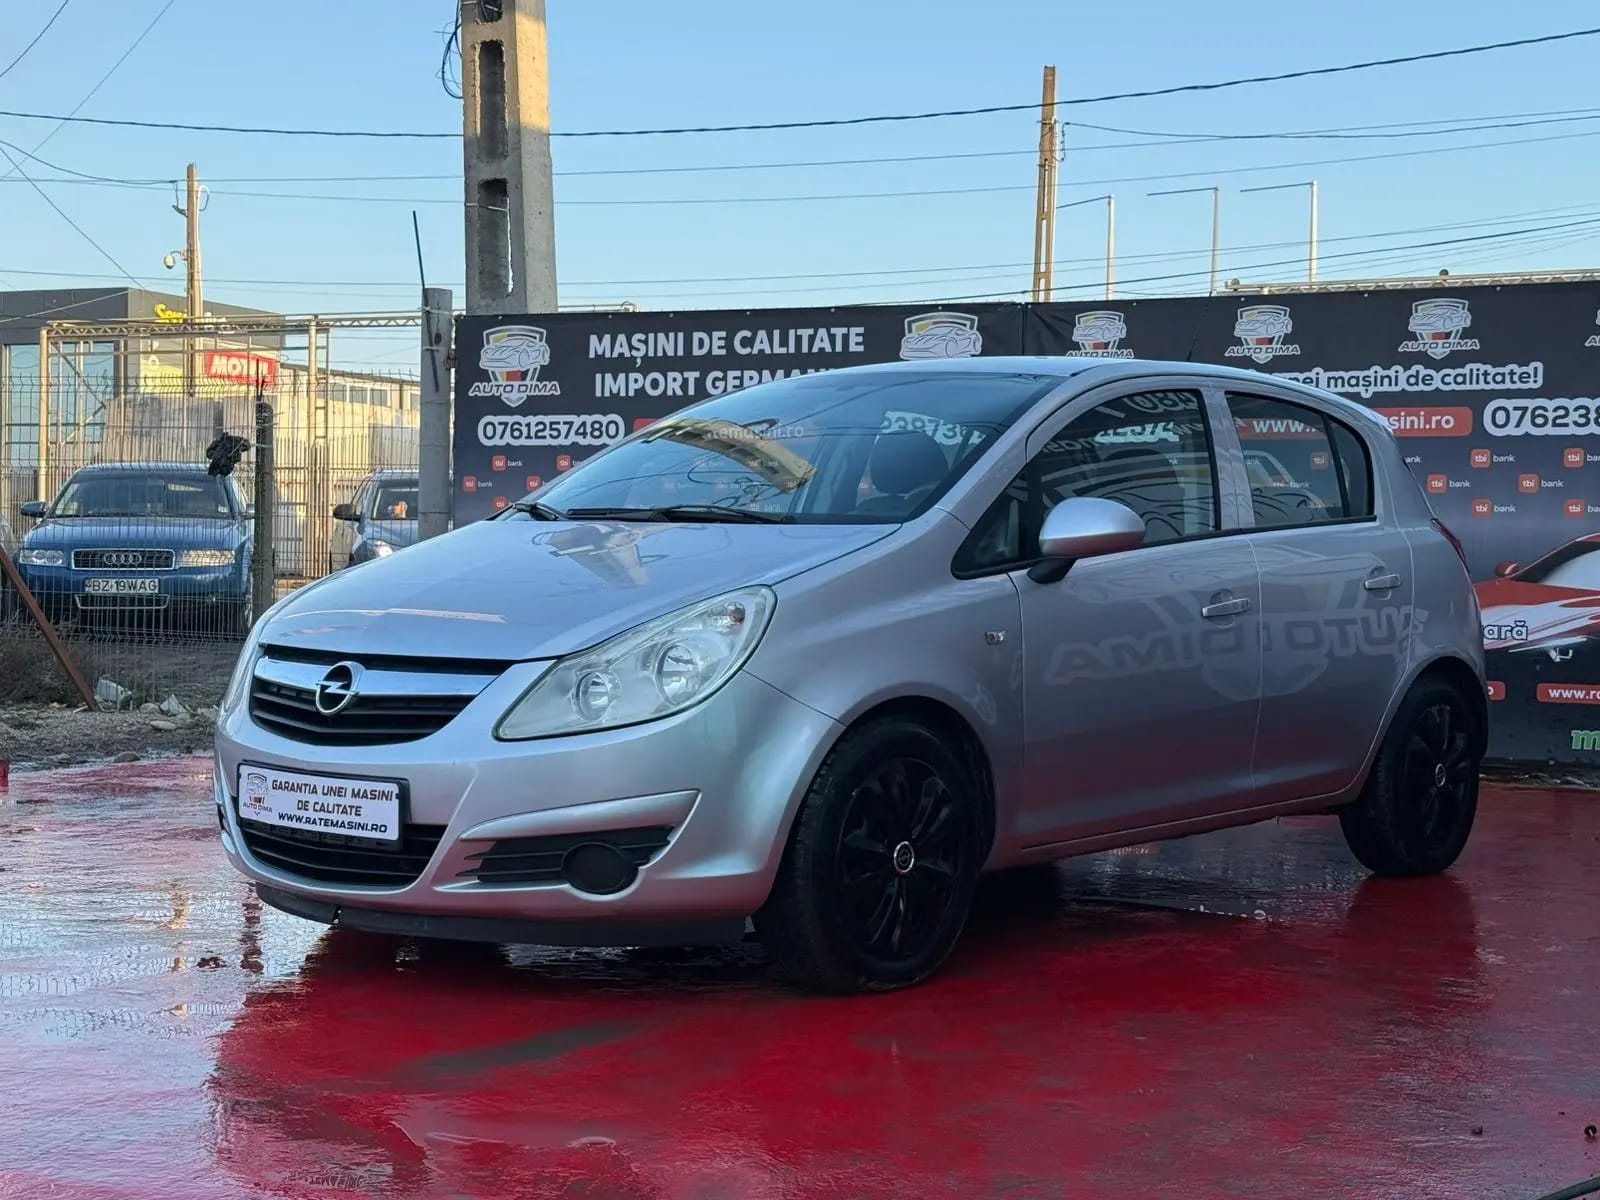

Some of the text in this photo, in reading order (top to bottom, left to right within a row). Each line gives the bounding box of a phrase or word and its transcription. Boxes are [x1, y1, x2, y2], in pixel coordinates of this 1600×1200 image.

[588, 327, 865, 367] MAȘINI DE CALITATE
[1225, 345, 1299, 356] AUTO DIMA
[1399, 340, 1479, 351] AUTO DIMA
[595, 370, 700, 397] IMPORT
[1327, 369, 1399, 394] mașini
[1406, 370, 1434, 387] de
[1441, 366, 1538, 386] calitate!
[470, 382, 560, 396] AUTO DIMA
[1389, 411, 1455, 429] sini.ro
[482, 419, 620, 440] 0761257480
[1405, 455, 1422, 463] ank
[1493, 454, 1516, 463] bank
[1449, 479, 1471, 488] bank
[1541, 479, 1563, 488] bank
[1494, 504, 1516, 513] bank
[1483, 620, 1528, 640] ară
[271, 779, 394, 802] GARANTIA UNEI MASINI
[297, 799, 362, 816] DE CALITATE
[278, 811, 388, 833] WWW.RATEMASINI.RO
